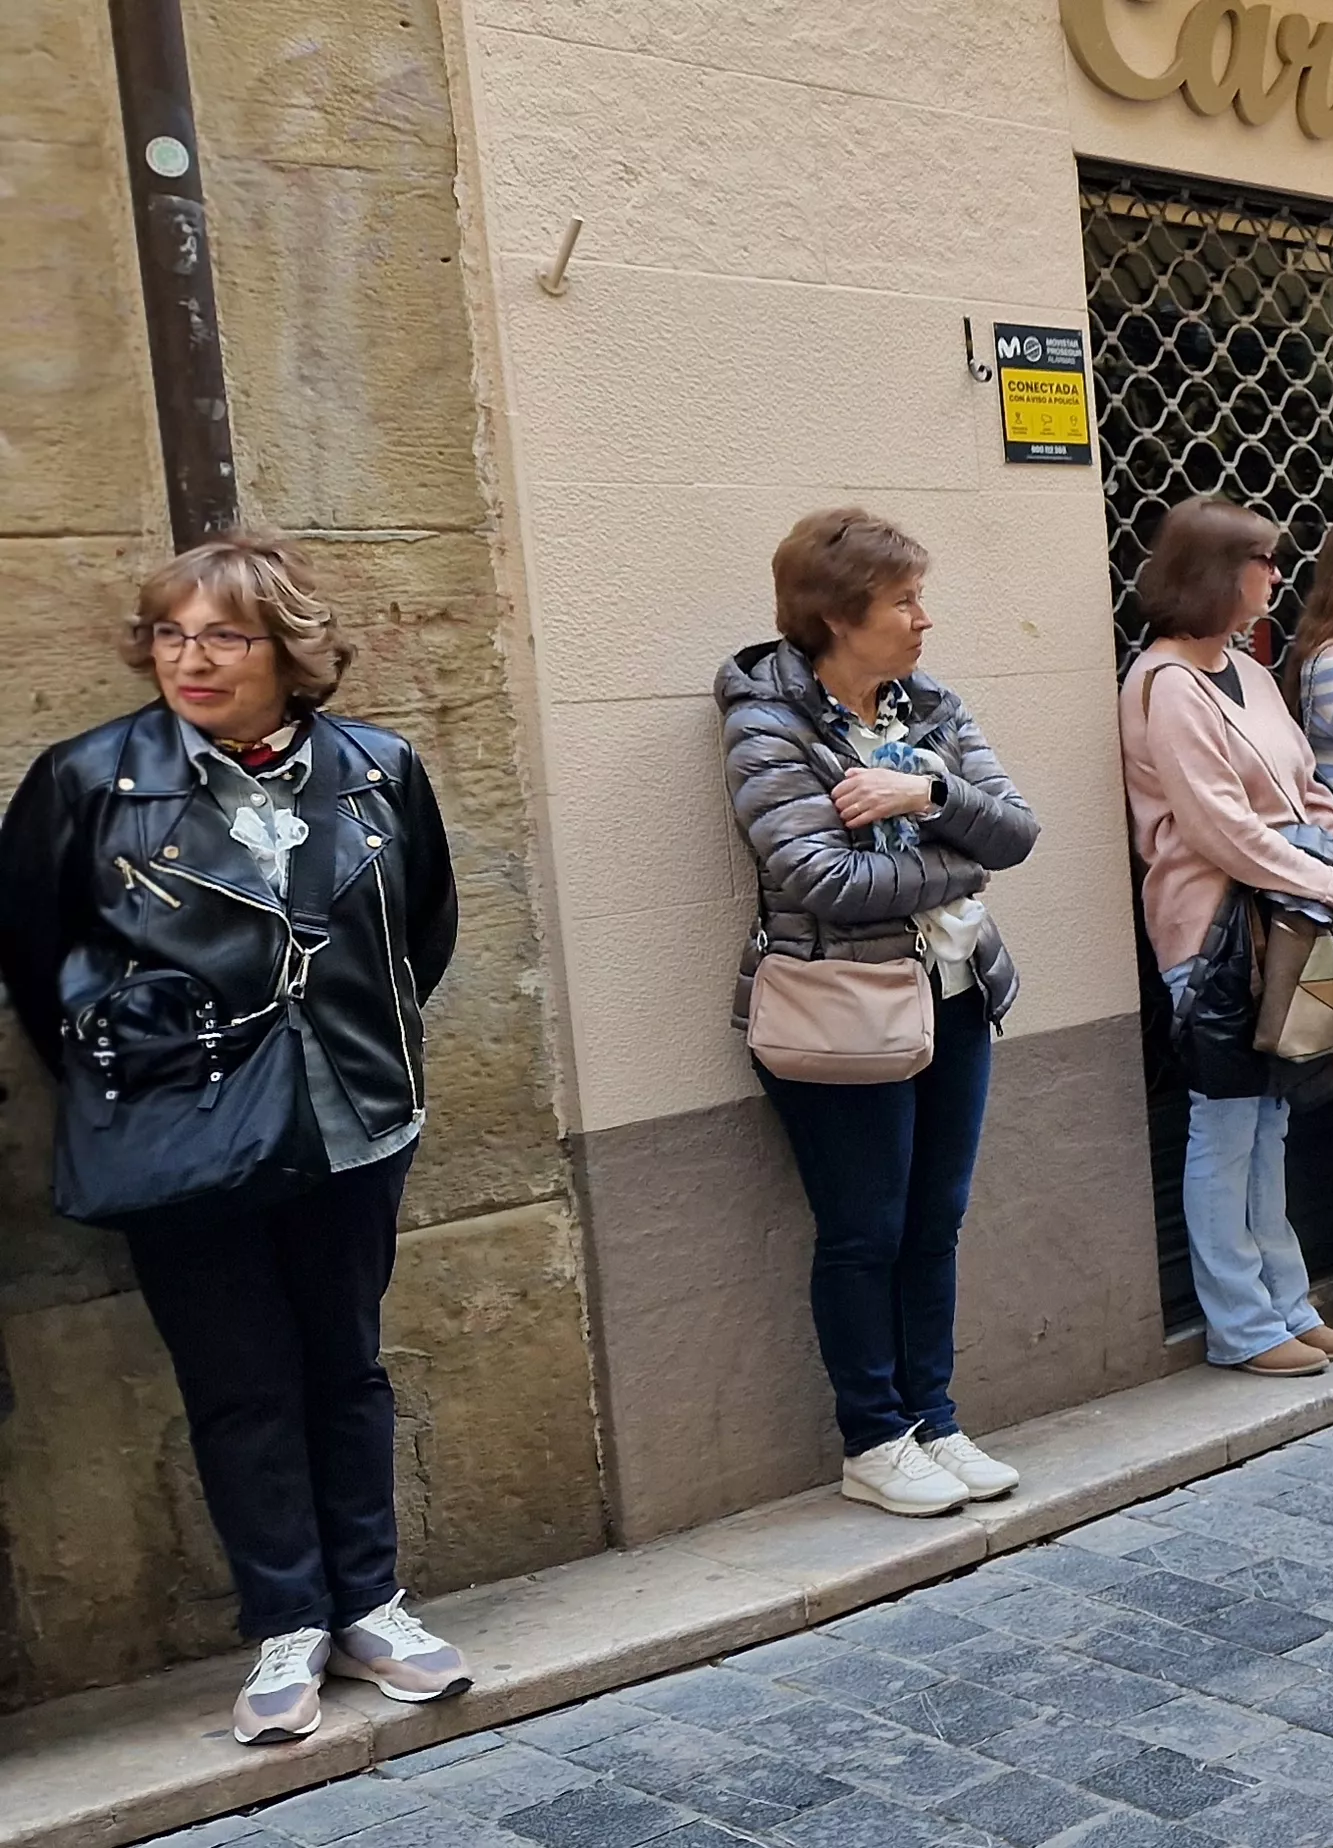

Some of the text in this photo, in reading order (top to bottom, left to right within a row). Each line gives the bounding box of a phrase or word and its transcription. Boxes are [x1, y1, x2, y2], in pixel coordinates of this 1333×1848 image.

[1008, 380, 1079, 395] CONECTADA
[1009, 394, 1025, 402] CON
[1026, 395, 1047, 404] AVISO
[1053, 397, 1080, 406] POLICÍA
